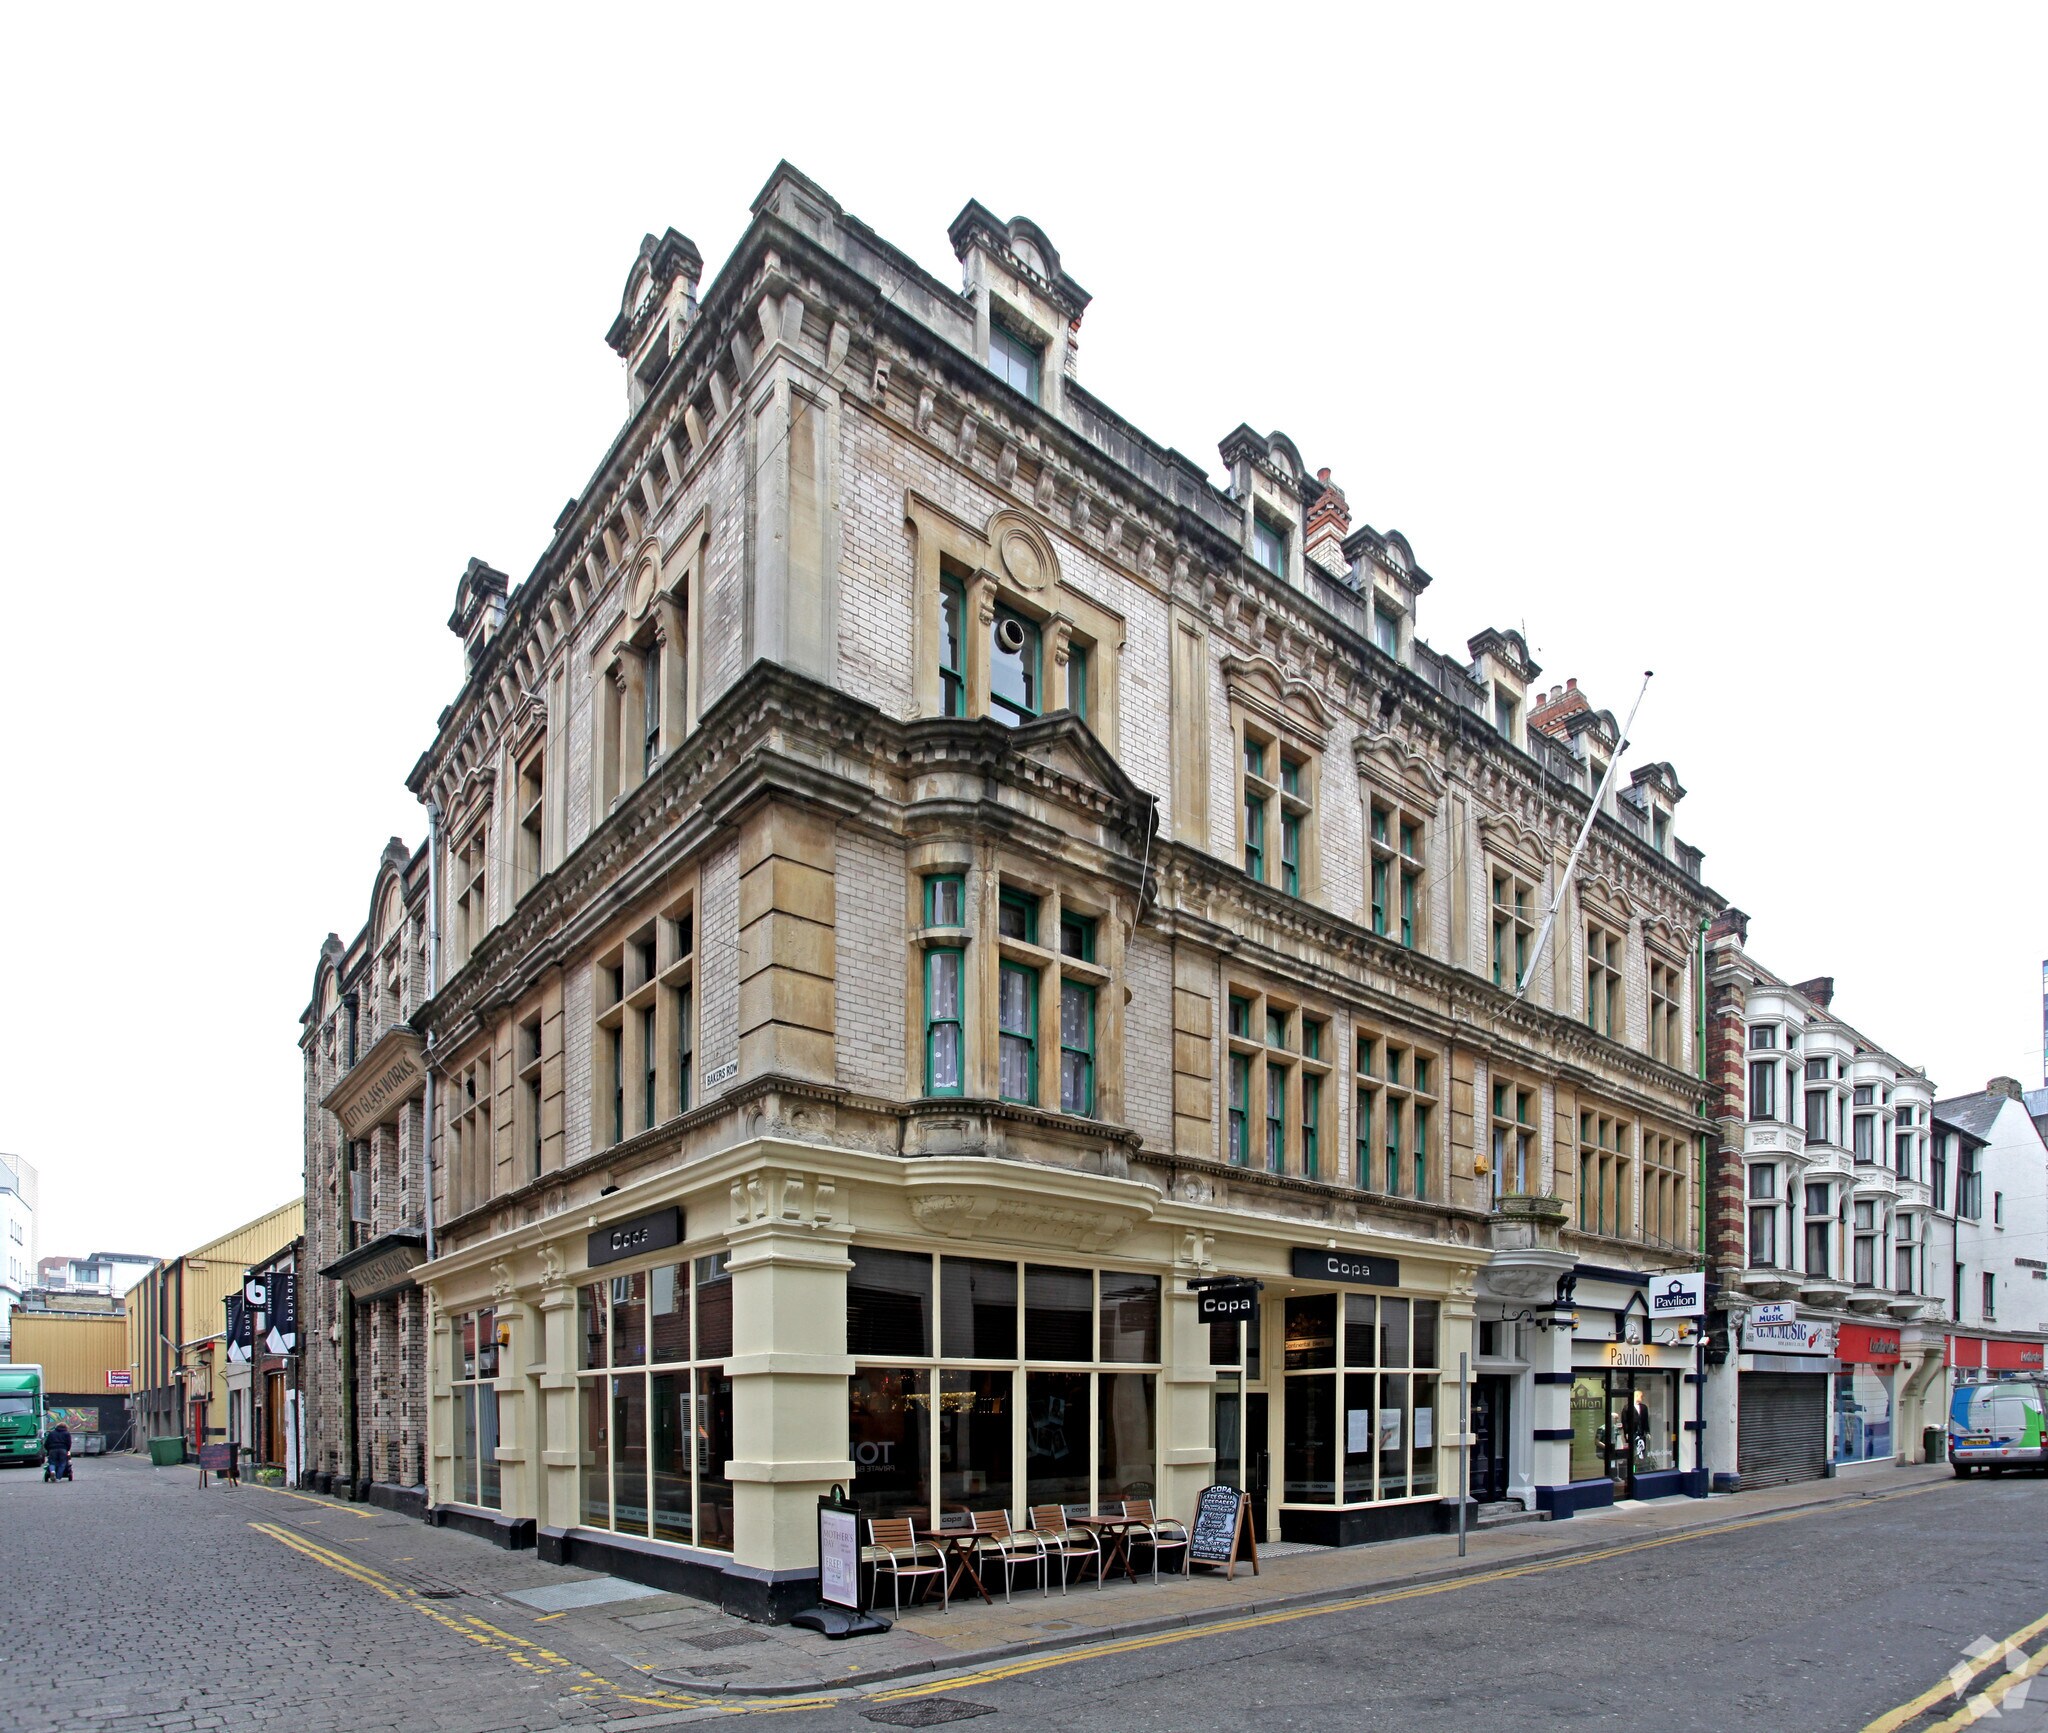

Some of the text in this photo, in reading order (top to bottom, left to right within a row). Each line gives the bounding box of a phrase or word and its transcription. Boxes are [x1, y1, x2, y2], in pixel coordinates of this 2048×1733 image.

[707, 1062, 738, 1086] BAKERS ROW
[344, 1102, 364, 1128] CITY
[360, 1082, 386, 1114] GLASS
[380, 1056, 415, 1095] WORKS
[610, 1228, 648, 1250] Copa
[349, 1273, 364, 1292] CITY
[361, 1263, 386, 1286] GLASS
[381, 1251, 414, 1279] WORKS
[1327, 1257, 1370, 1276] Copa
[286, 1275, 294, 1322] bauhaus
[1656, 1295, 1695, 1307] Pavilion
[1204, 1298, 1250, 1313] Copa
[1759, 1314, 1783, 1322] MUSIC
[1611, 1347, 1650, 1366] Pavilion
[1570, 1398, 1601, 1409] avilion
[1211, 1485, 1232, 1494] COPA
[1071, 1506, 1089, 1514] copa
[942, 1516, 962, 1524] copa
[823, 1530, 854, 1543] MOTHER'S
[823, 1538, 835, 1548] DAY
[826, 1557, 842, 1569] FREE!
